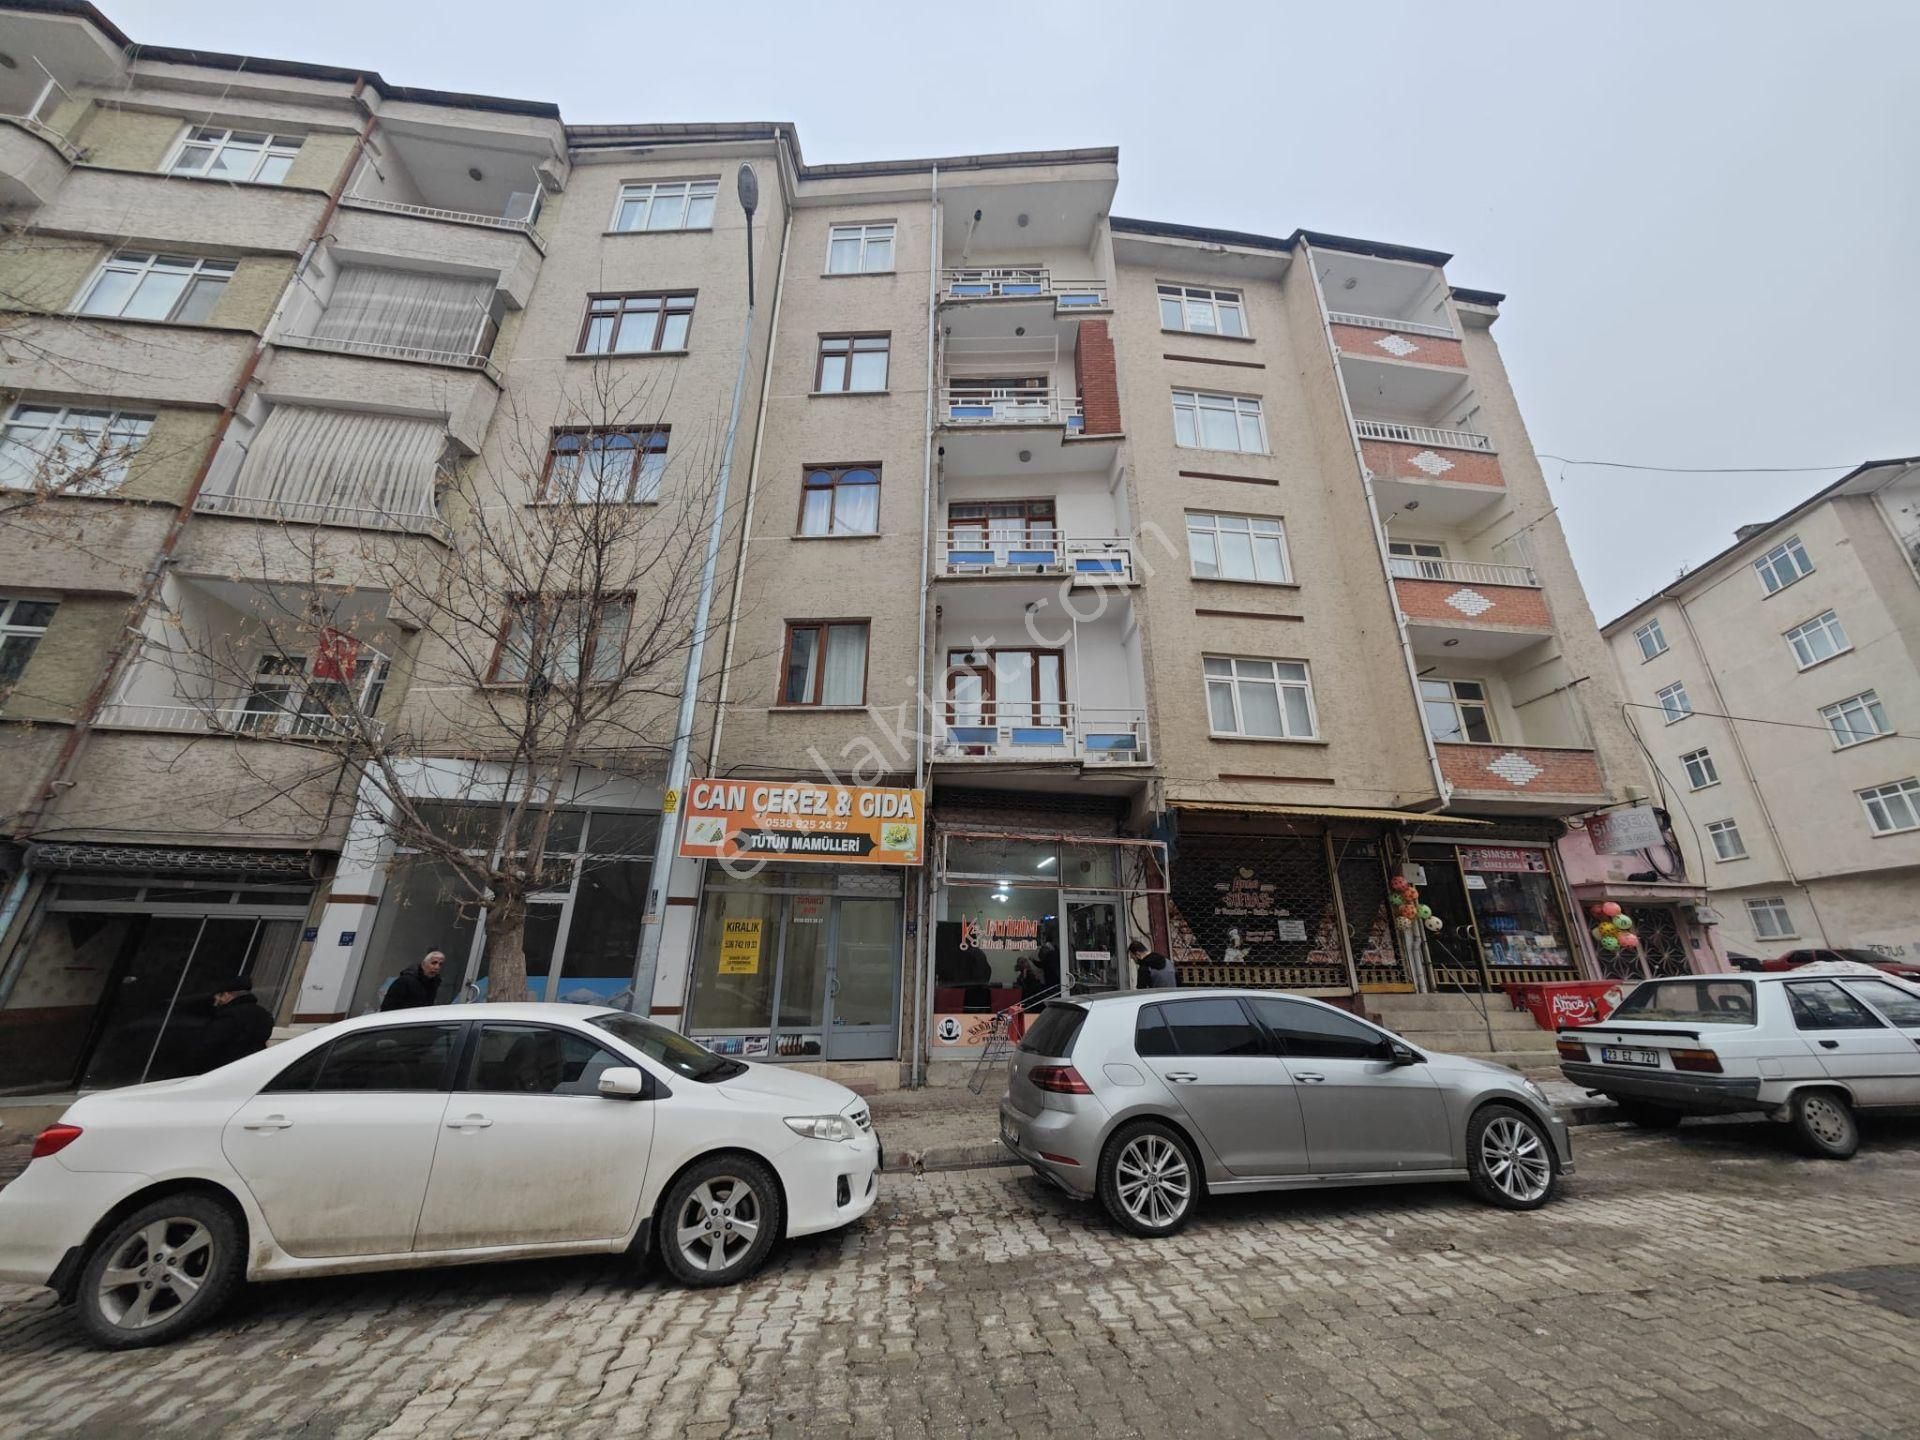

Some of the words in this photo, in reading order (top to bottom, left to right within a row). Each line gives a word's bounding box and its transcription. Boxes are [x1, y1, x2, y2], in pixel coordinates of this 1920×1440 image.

[693, 784, 747, 812] CAN
[752, 787, 828, 819] ÇEREZ
[837, 791, 853, 815] &
[859, 792, 915, 819] GIDA
[751, 833, 789, 849] TÜTÜN
[791, 835, 860, 852] MAMÜLLERİ
[1640, 1052, 1656, 1063] 727
